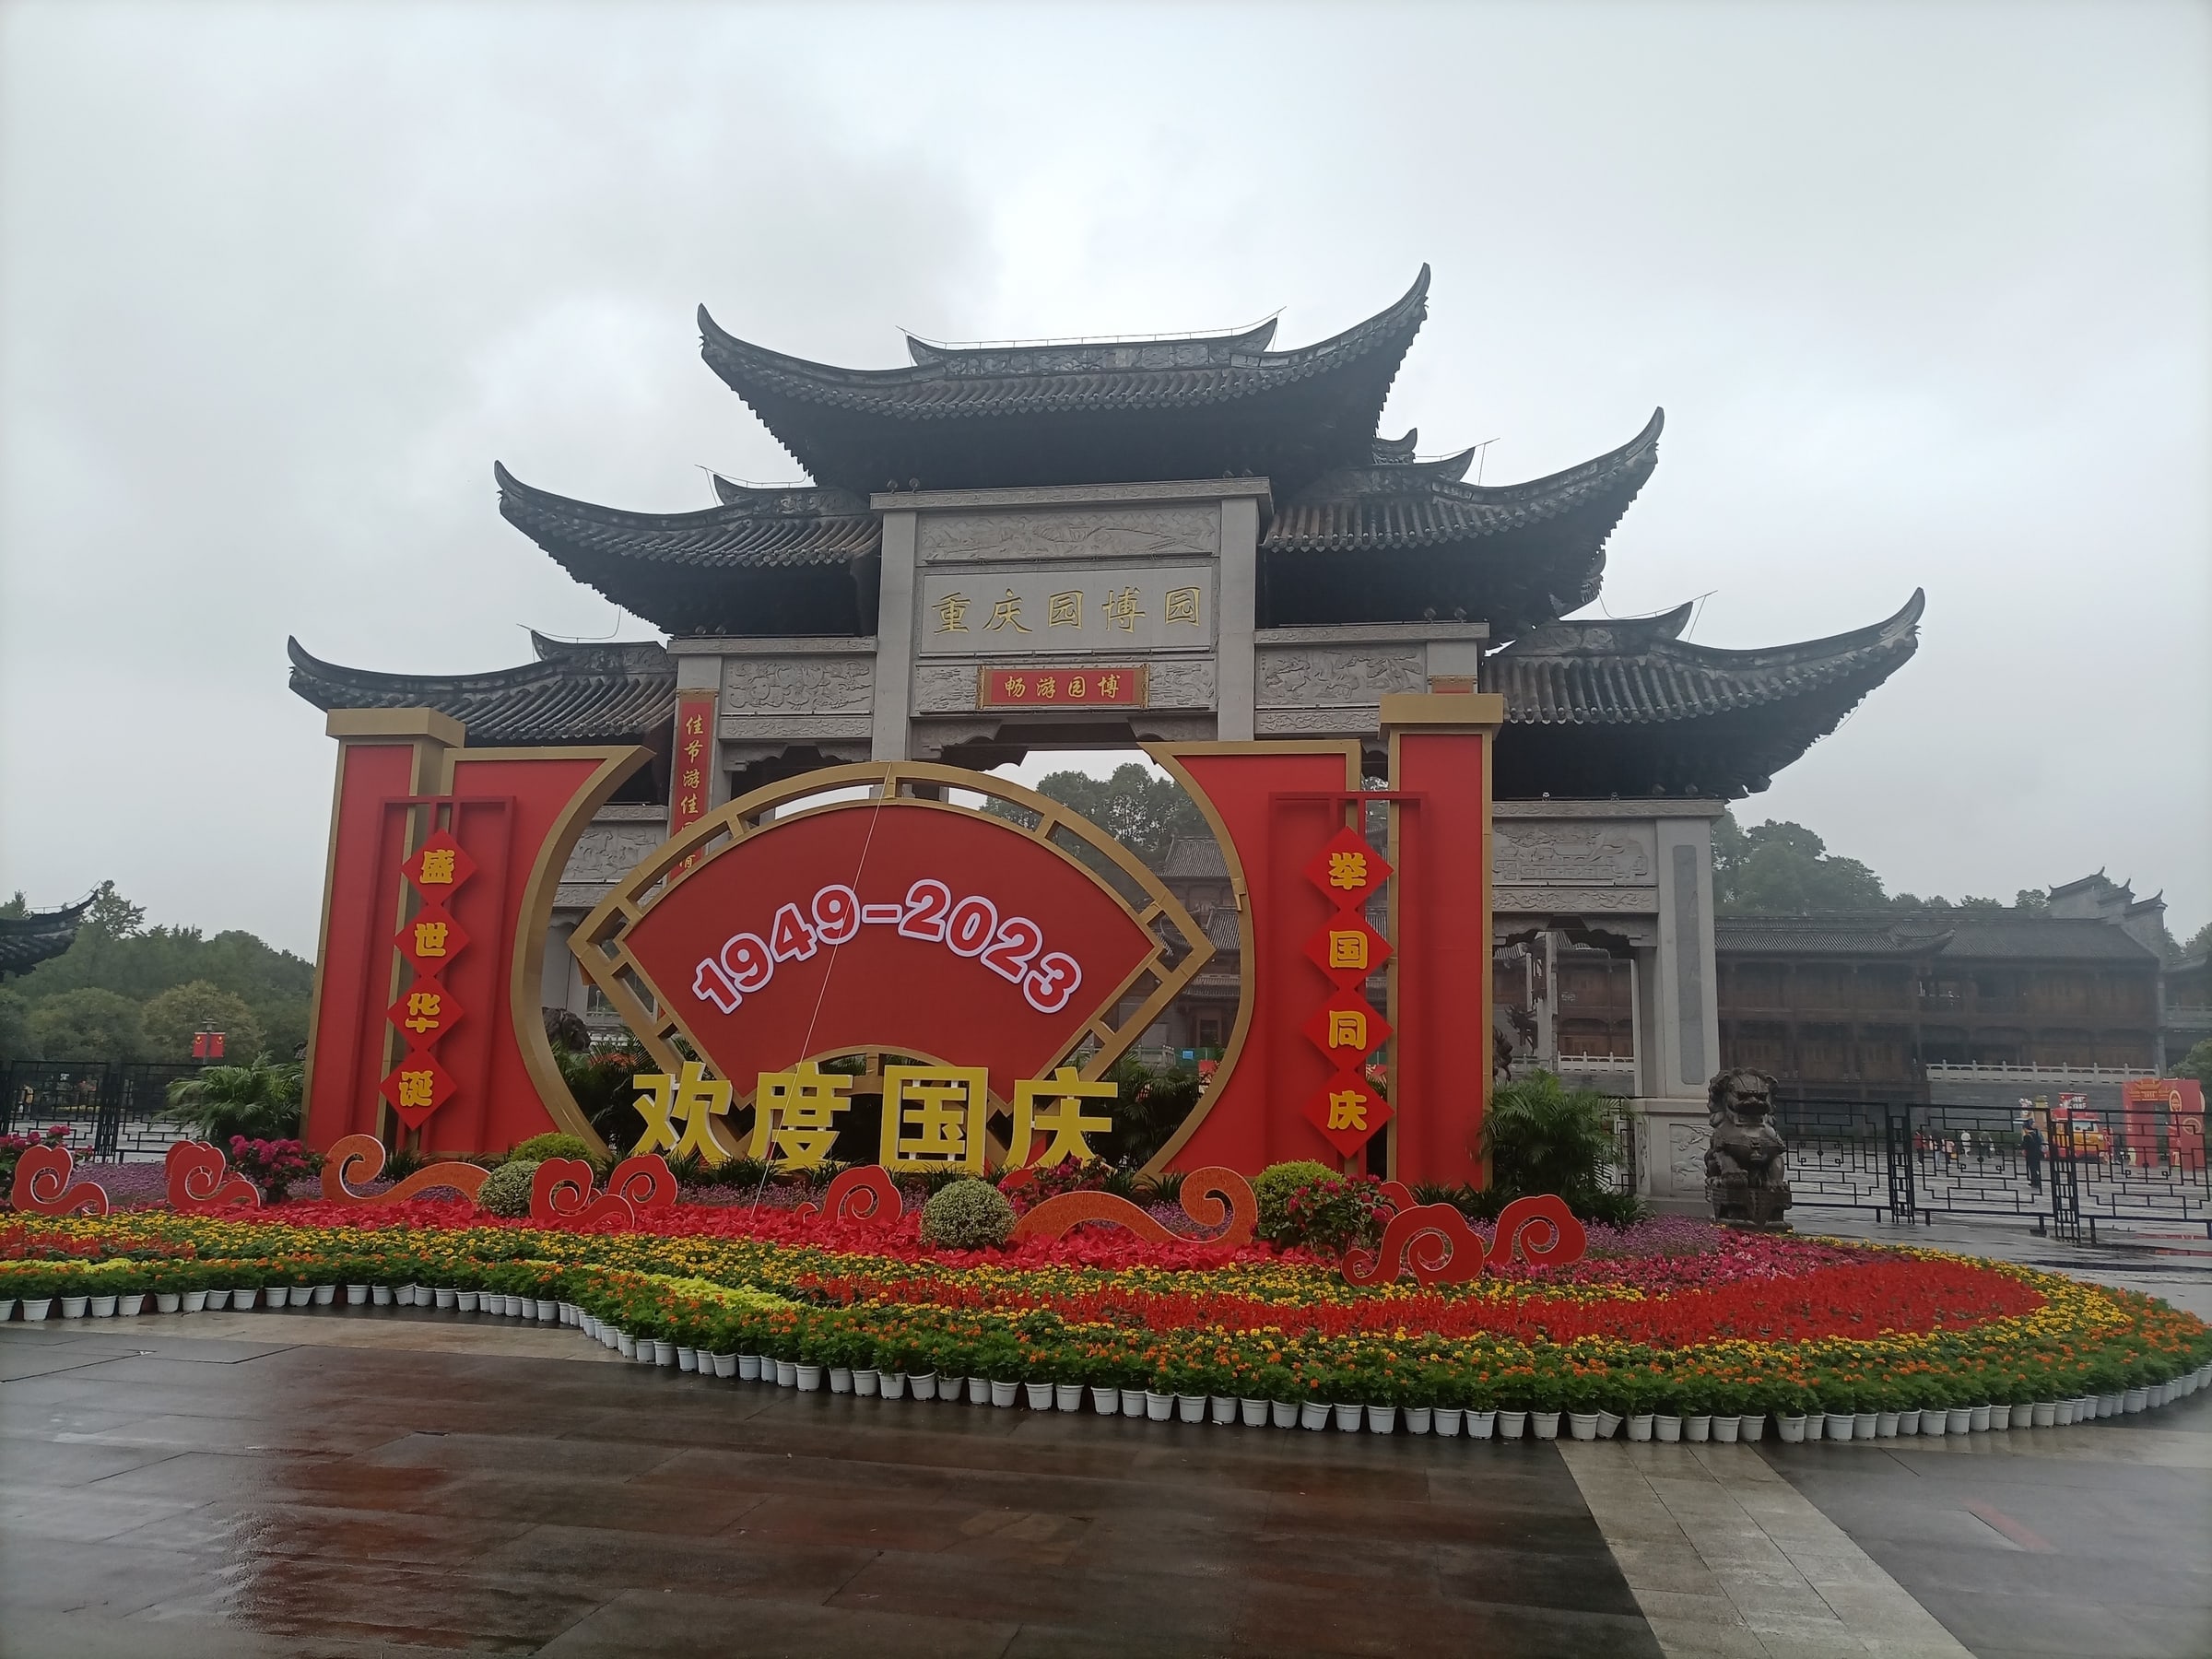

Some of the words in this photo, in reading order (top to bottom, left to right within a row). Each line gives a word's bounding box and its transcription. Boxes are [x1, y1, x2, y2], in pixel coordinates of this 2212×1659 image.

[932, 585, 1201, 634] 重庆园博园
[1004, 674, 1121, 700] 畅游园博
[398, 849, 455, 1107] 盛世华诞
[692, 878, 1082, 1014] 1949-2023
[1327, 853, 1369, 1131] 举国同庆
[632, 1061, 1118, 1173] 欢度国庆
